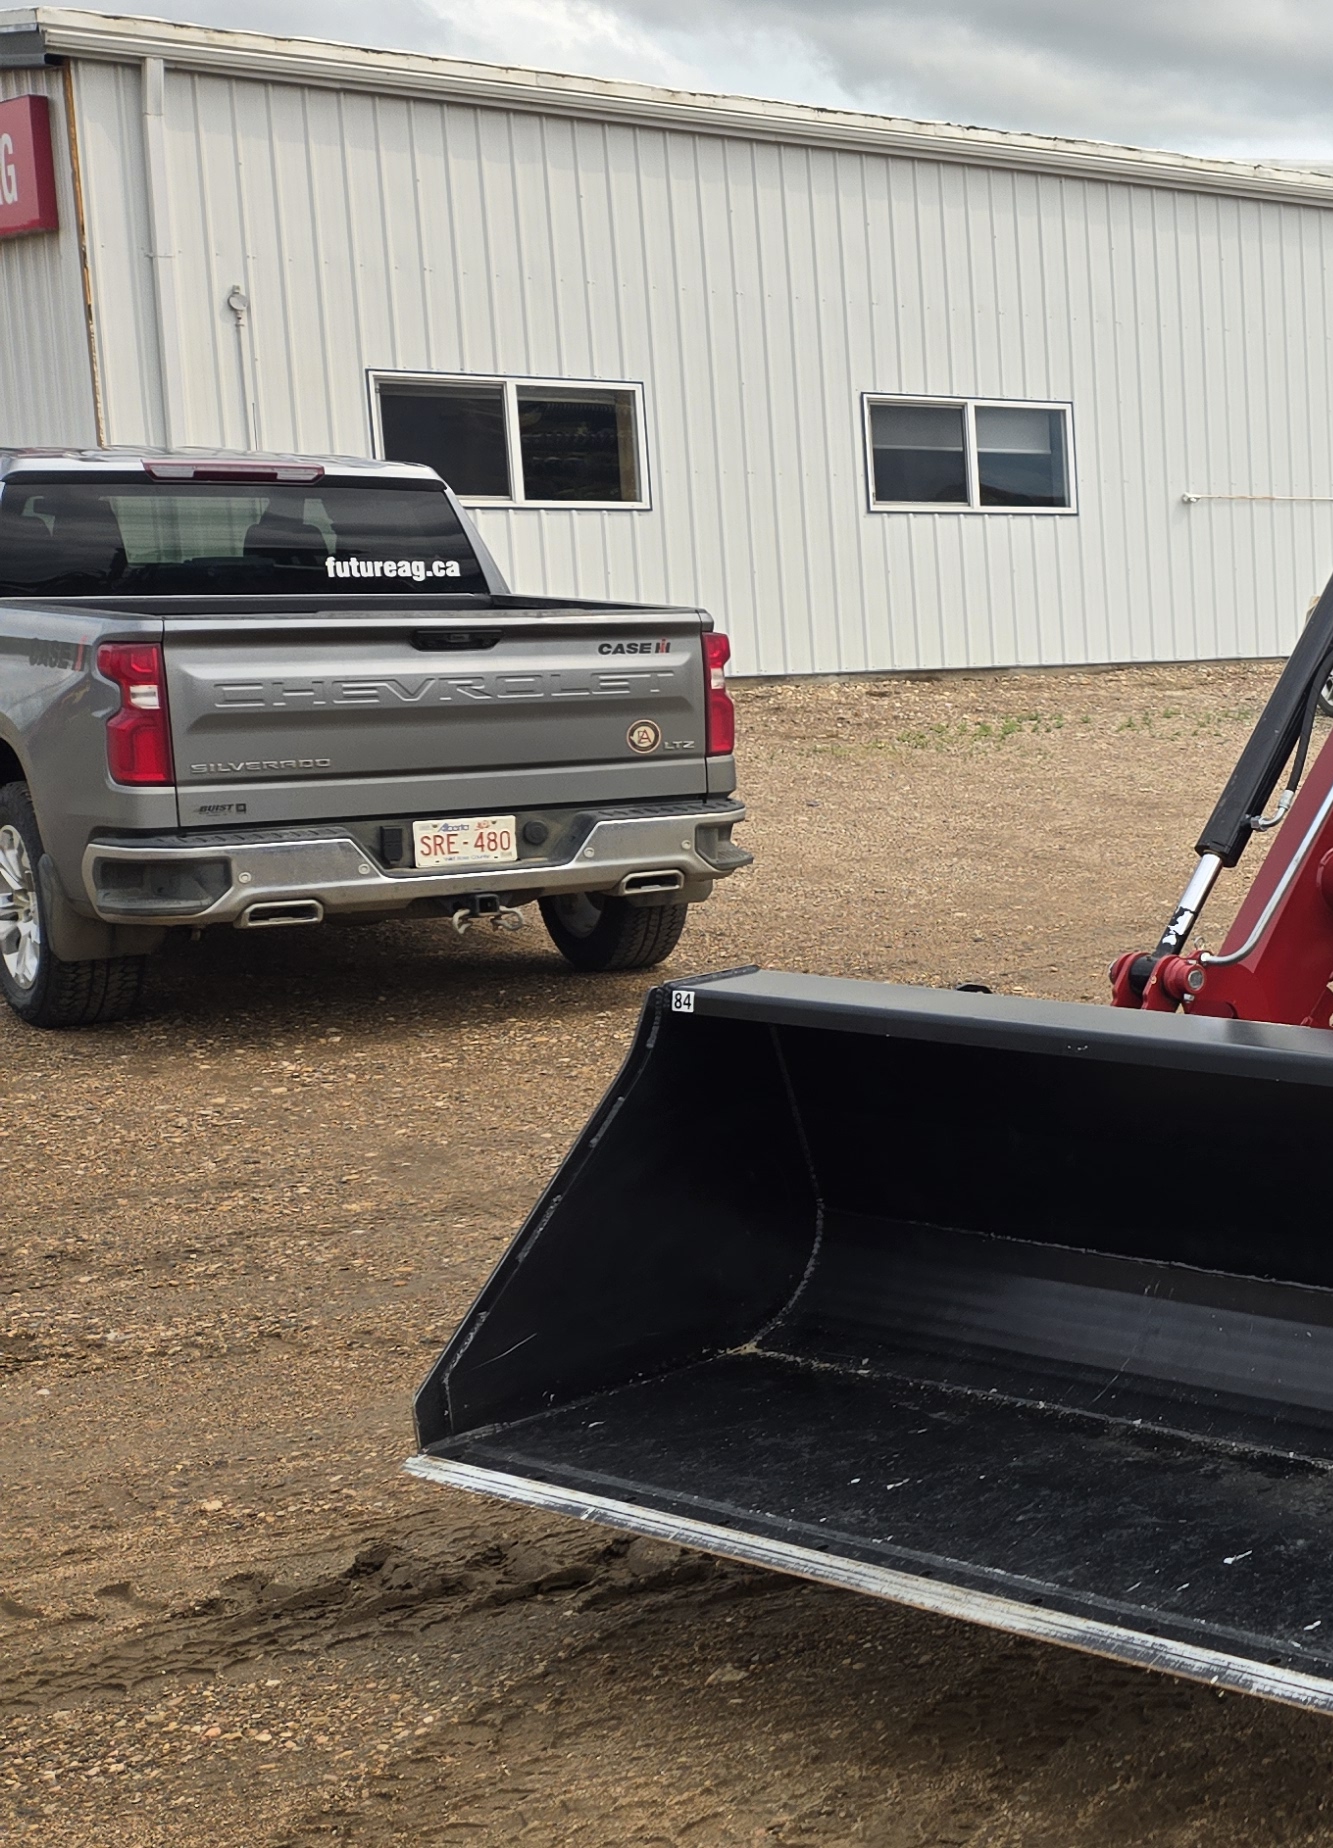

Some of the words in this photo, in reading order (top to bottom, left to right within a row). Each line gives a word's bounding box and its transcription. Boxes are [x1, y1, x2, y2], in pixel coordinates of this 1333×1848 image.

[0, 132, 18, 205] G
[325, 556, 461, 581] futureag.ca
[598, 642, 652, 655] CASE
[213, 670, 674, 707] CHEVROLET
[664, 740, 695, 750] LTZ
[191, 758, 331, 774] SILVERADO
[674, 992, 692, 1010] 84
